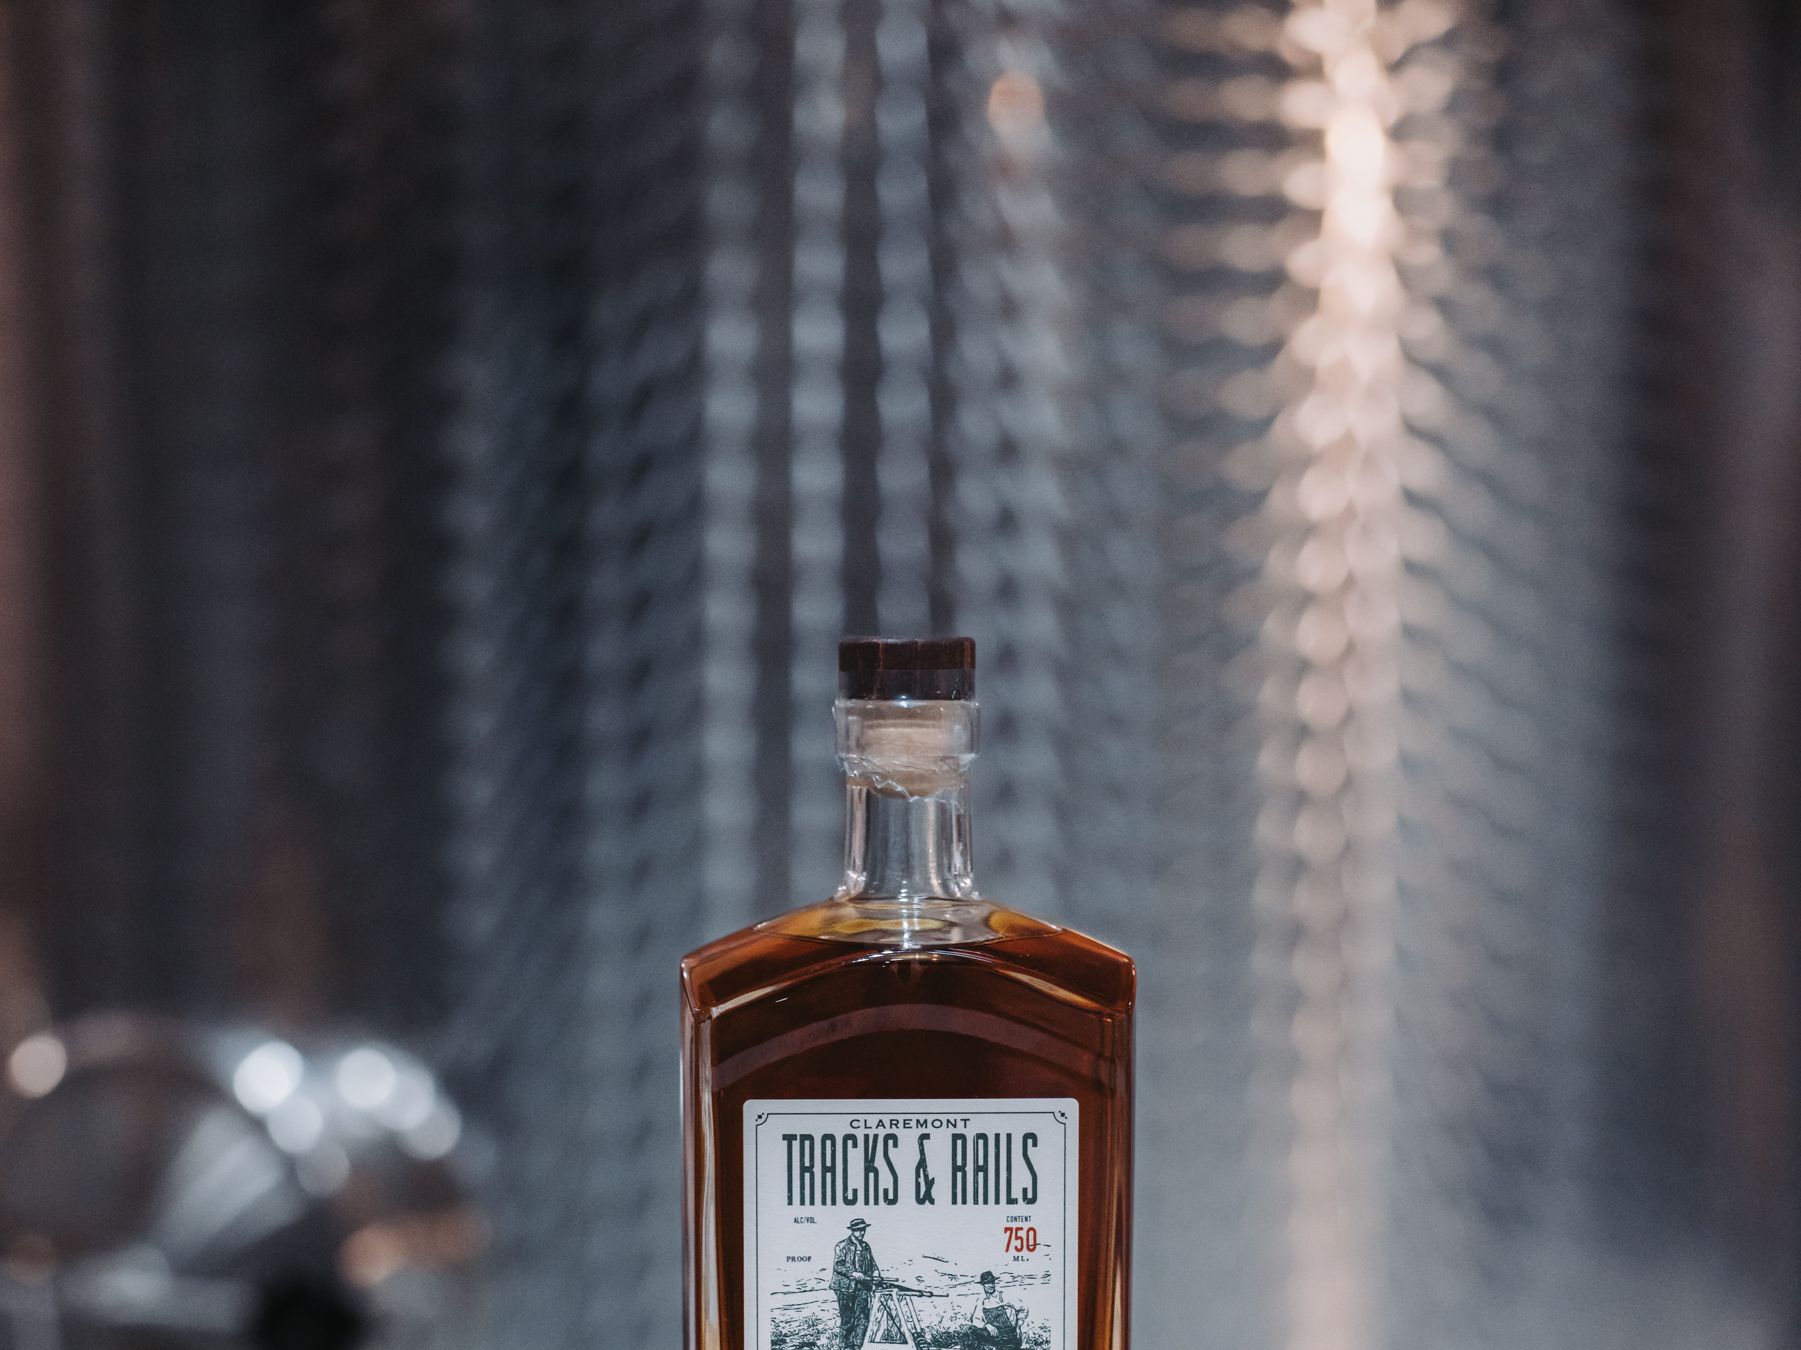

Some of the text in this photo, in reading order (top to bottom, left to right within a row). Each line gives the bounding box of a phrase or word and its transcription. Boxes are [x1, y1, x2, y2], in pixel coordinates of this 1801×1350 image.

[849, 1118, 971, 1129] CLAREMONT
[782, 1132, 1038, 1206] TRACKS & RAILS
[1006, 1215, 1032, 1223] CONTENT
[1003, 1226, 1037, 1253] 750
[786, 1255, 812, 1263] PROOF
